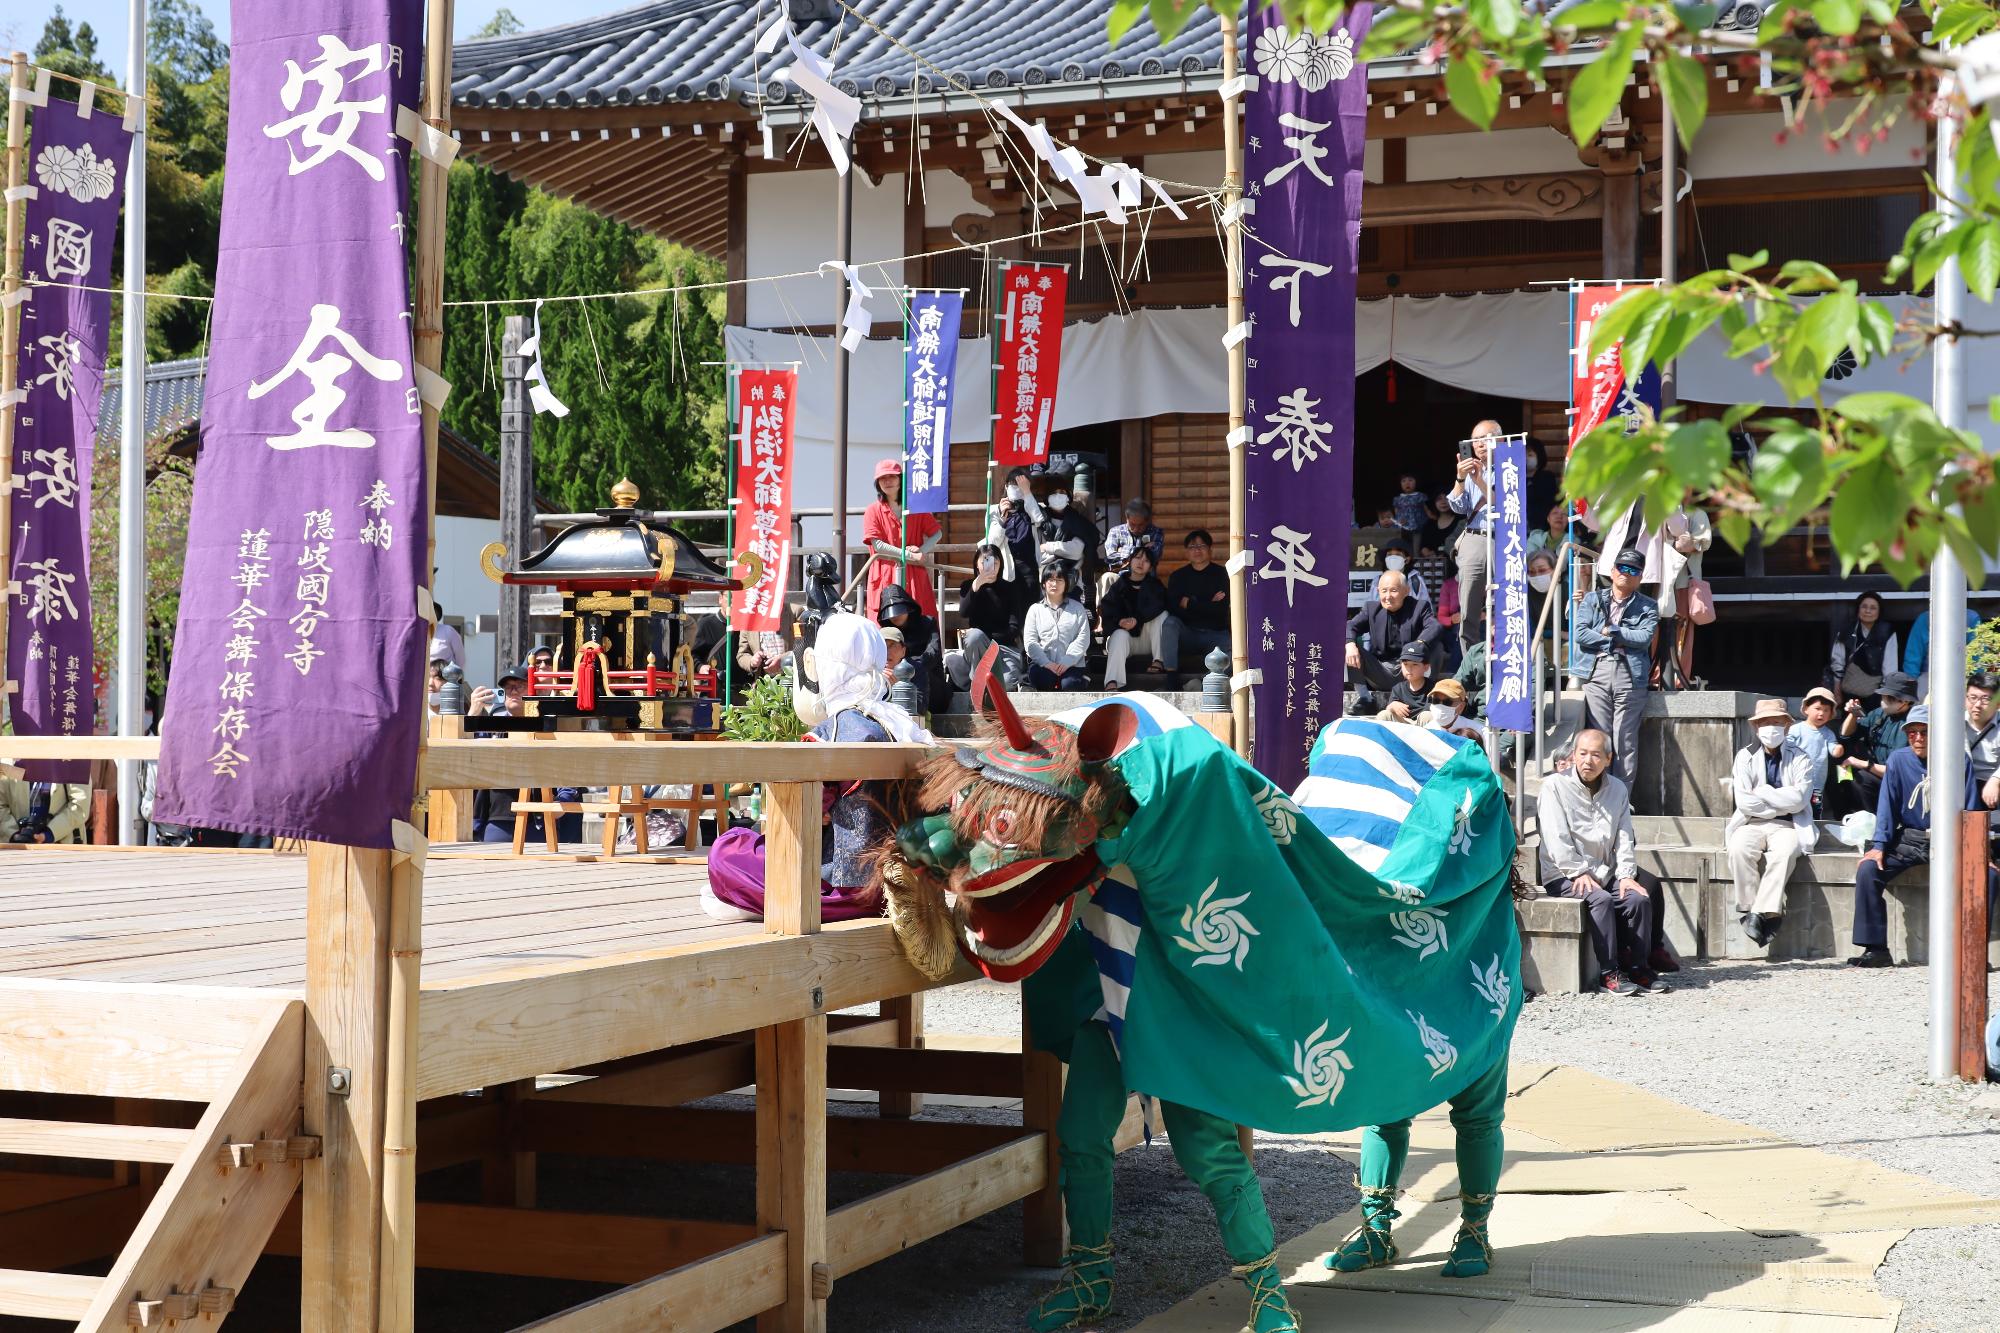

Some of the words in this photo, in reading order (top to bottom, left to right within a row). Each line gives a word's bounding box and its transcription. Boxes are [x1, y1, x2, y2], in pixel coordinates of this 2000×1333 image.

[248, 34, 404, 451] 安全
[283, 509, 336, 677] 隠岐國分寺
[358, 479, 396, 552] 奉納
[207, 528, 273, 779] 蓮華会舞保存会
